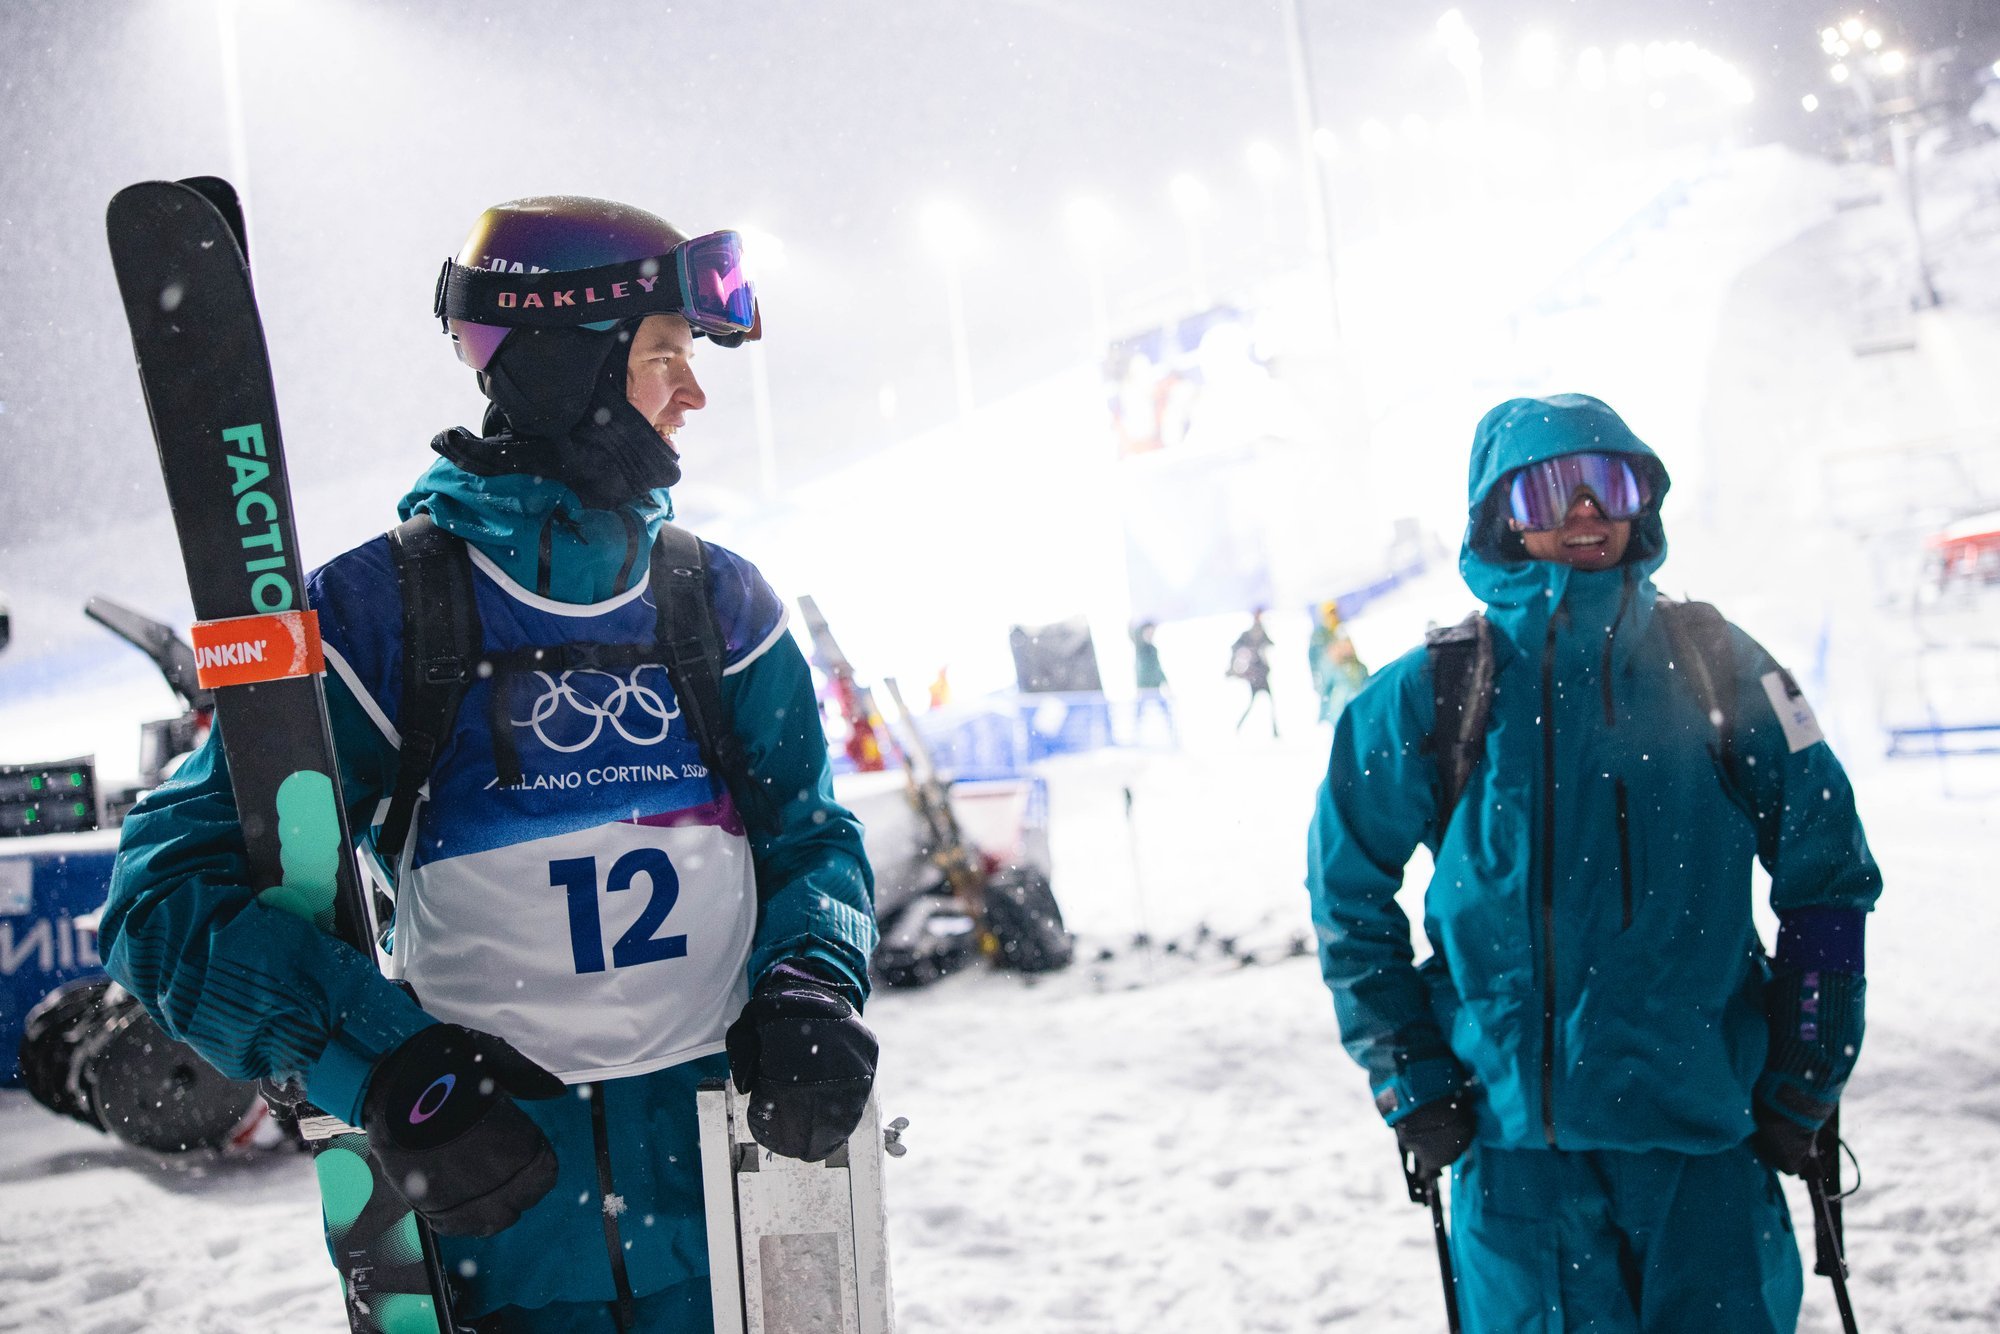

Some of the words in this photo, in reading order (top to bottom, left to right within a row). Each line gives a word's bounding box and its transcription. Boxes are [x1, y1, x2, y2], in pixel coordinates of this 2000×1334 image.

[498, 275, 658, 309] OAKLEY
[586, 764, 679, 786] CORTINA
[548, 847, 688, 975] 12
